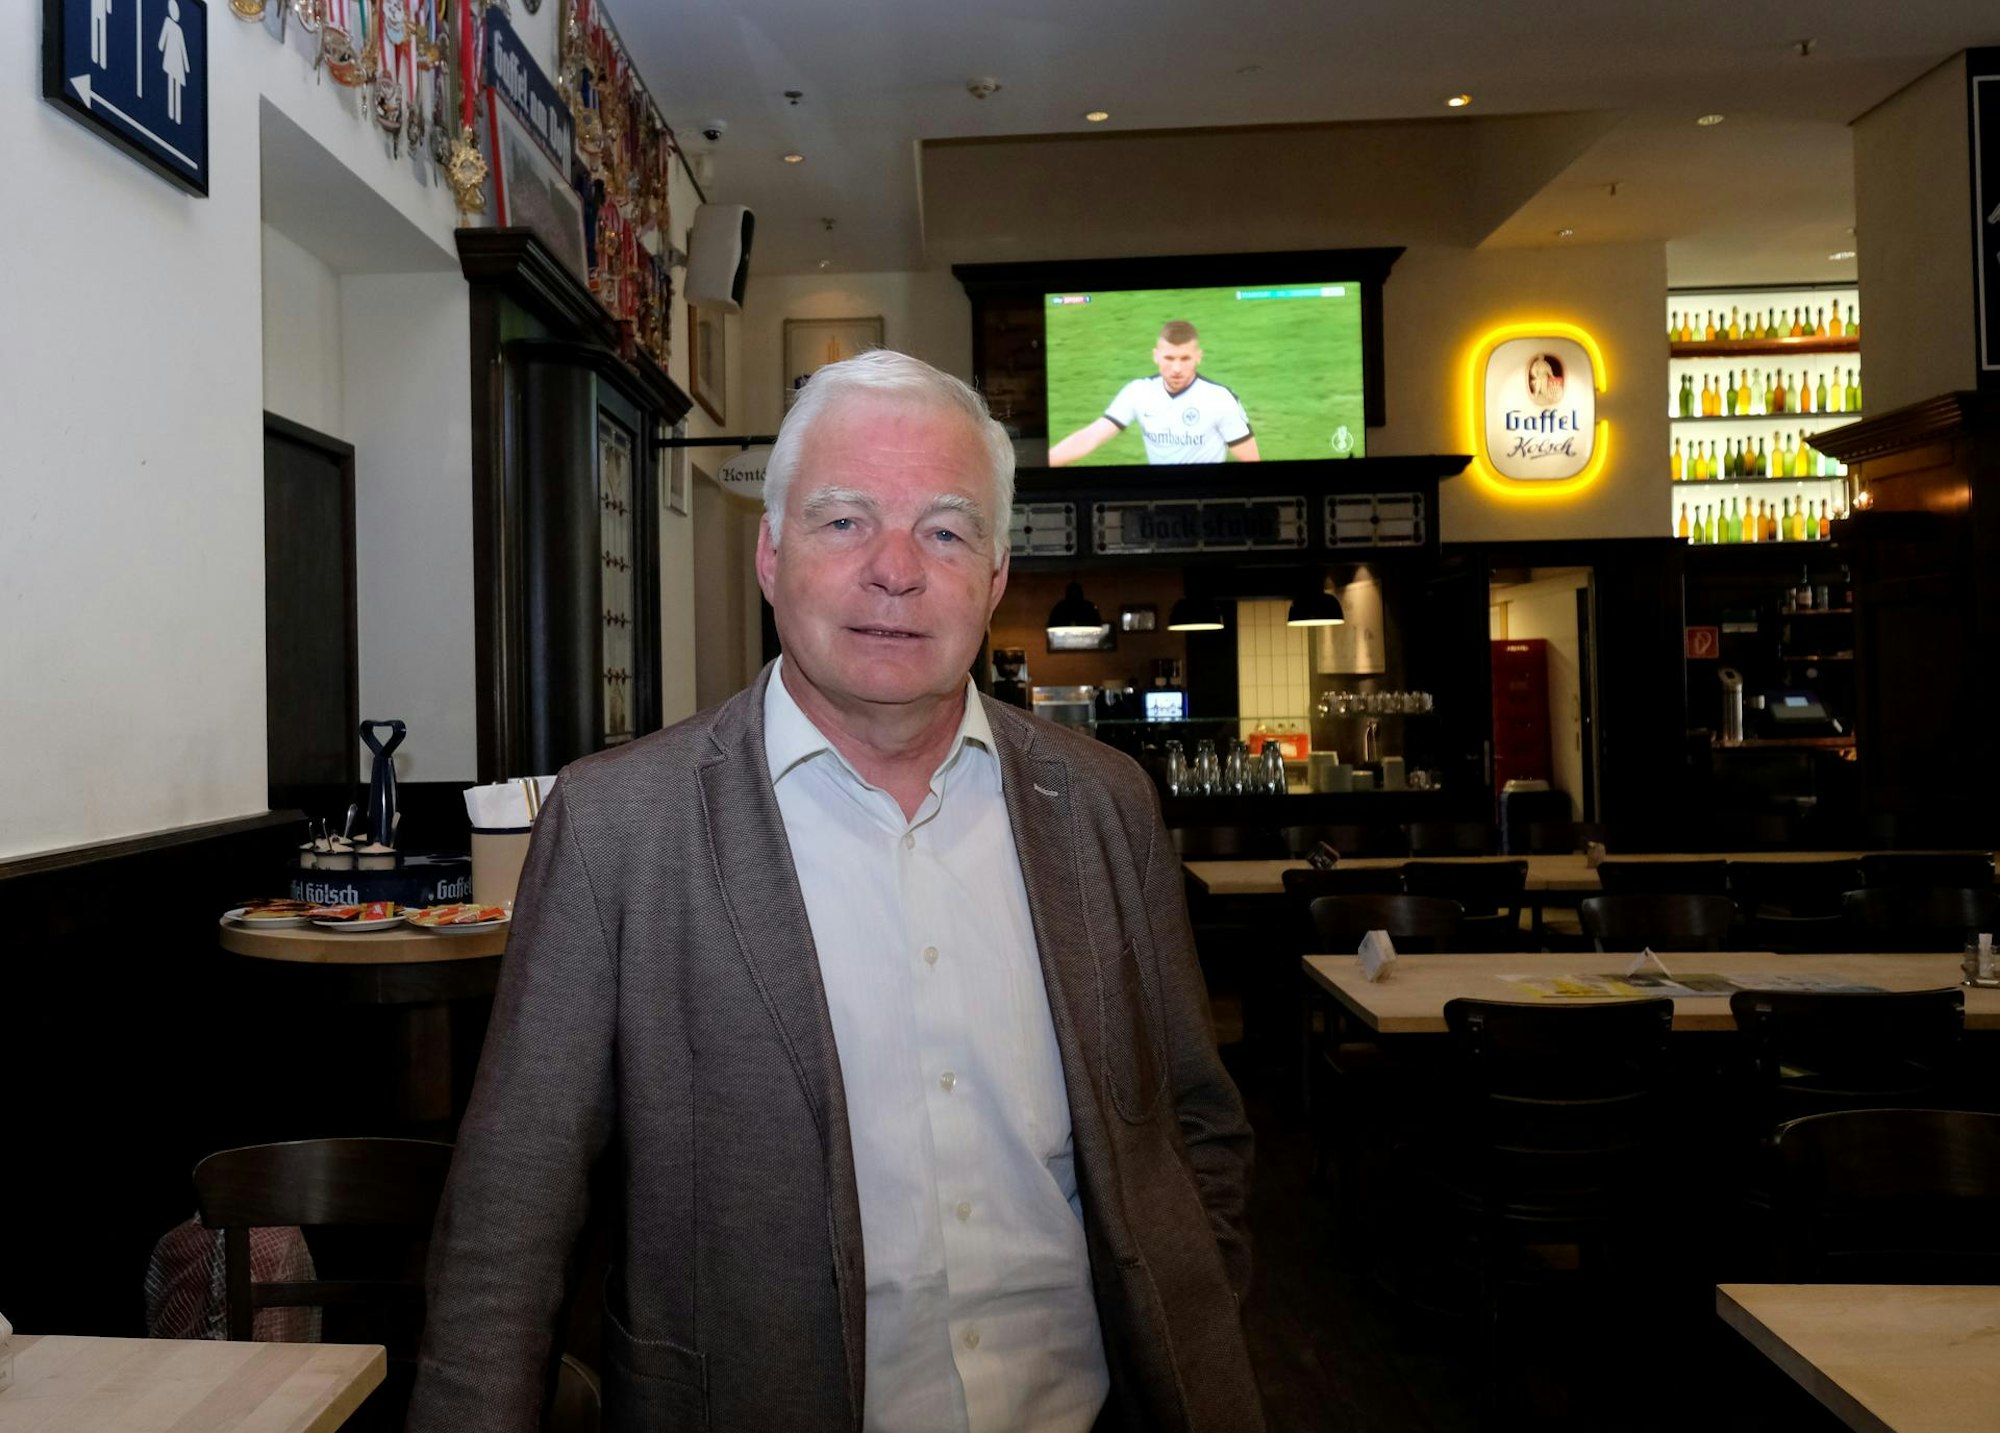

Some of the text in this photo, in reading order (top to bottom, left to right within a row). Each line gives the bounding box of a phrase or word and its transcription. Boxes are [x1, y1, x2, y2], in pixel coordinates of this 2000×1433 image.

[494, 30, 530, 113] Gaffel
[1505, 409, 1580, 433] Gaffel
[306, 882, 359, 905] Kölsch
